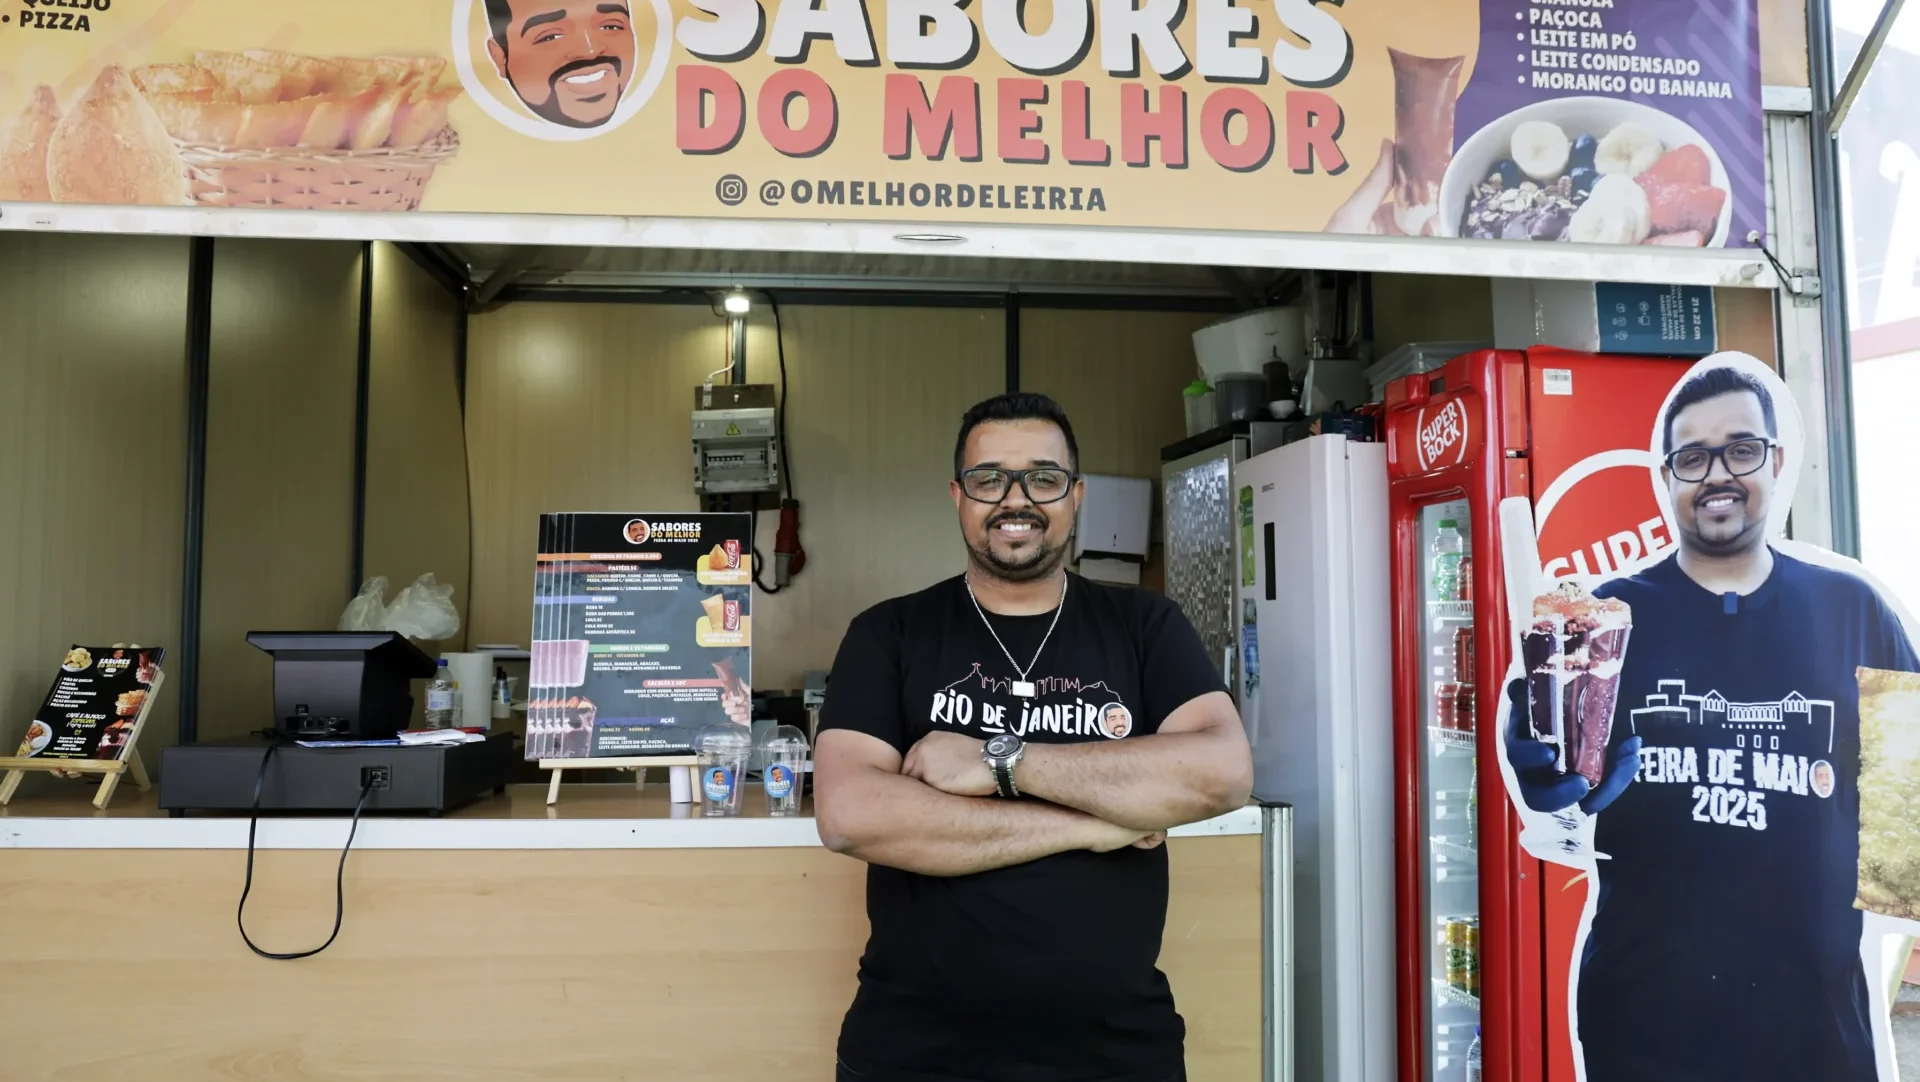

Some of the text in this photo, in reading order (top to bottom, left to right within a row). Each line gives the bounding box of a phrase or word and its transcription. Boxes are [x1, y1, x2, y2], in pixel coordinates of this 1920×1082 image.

[20, 10, 90, 32] PIZZA
[1529, 8, 1602, 29] PAÇOCA
[1530, 29, 1637, 51] LEITE EM PÓ
[1531, 50, 1700, 76] LEITE CONDENSADO
[1532, 71, 1733, 99] MORANGO OU BANANA
[677, 64, 1350, 176] DO MELHOR
[758, 178, 1107, 213] @OMELHORDELEIRIA
[1422, 402, 1457, 448] SUPER
[1426, 420, 1461, 464] BOCK
[650, 522, 701, 532] SABORES
[981, 704, 1006, 727] DE
[1707, 748, 1745, 786] DE
[1692, 786, 1768, 831] 2025
